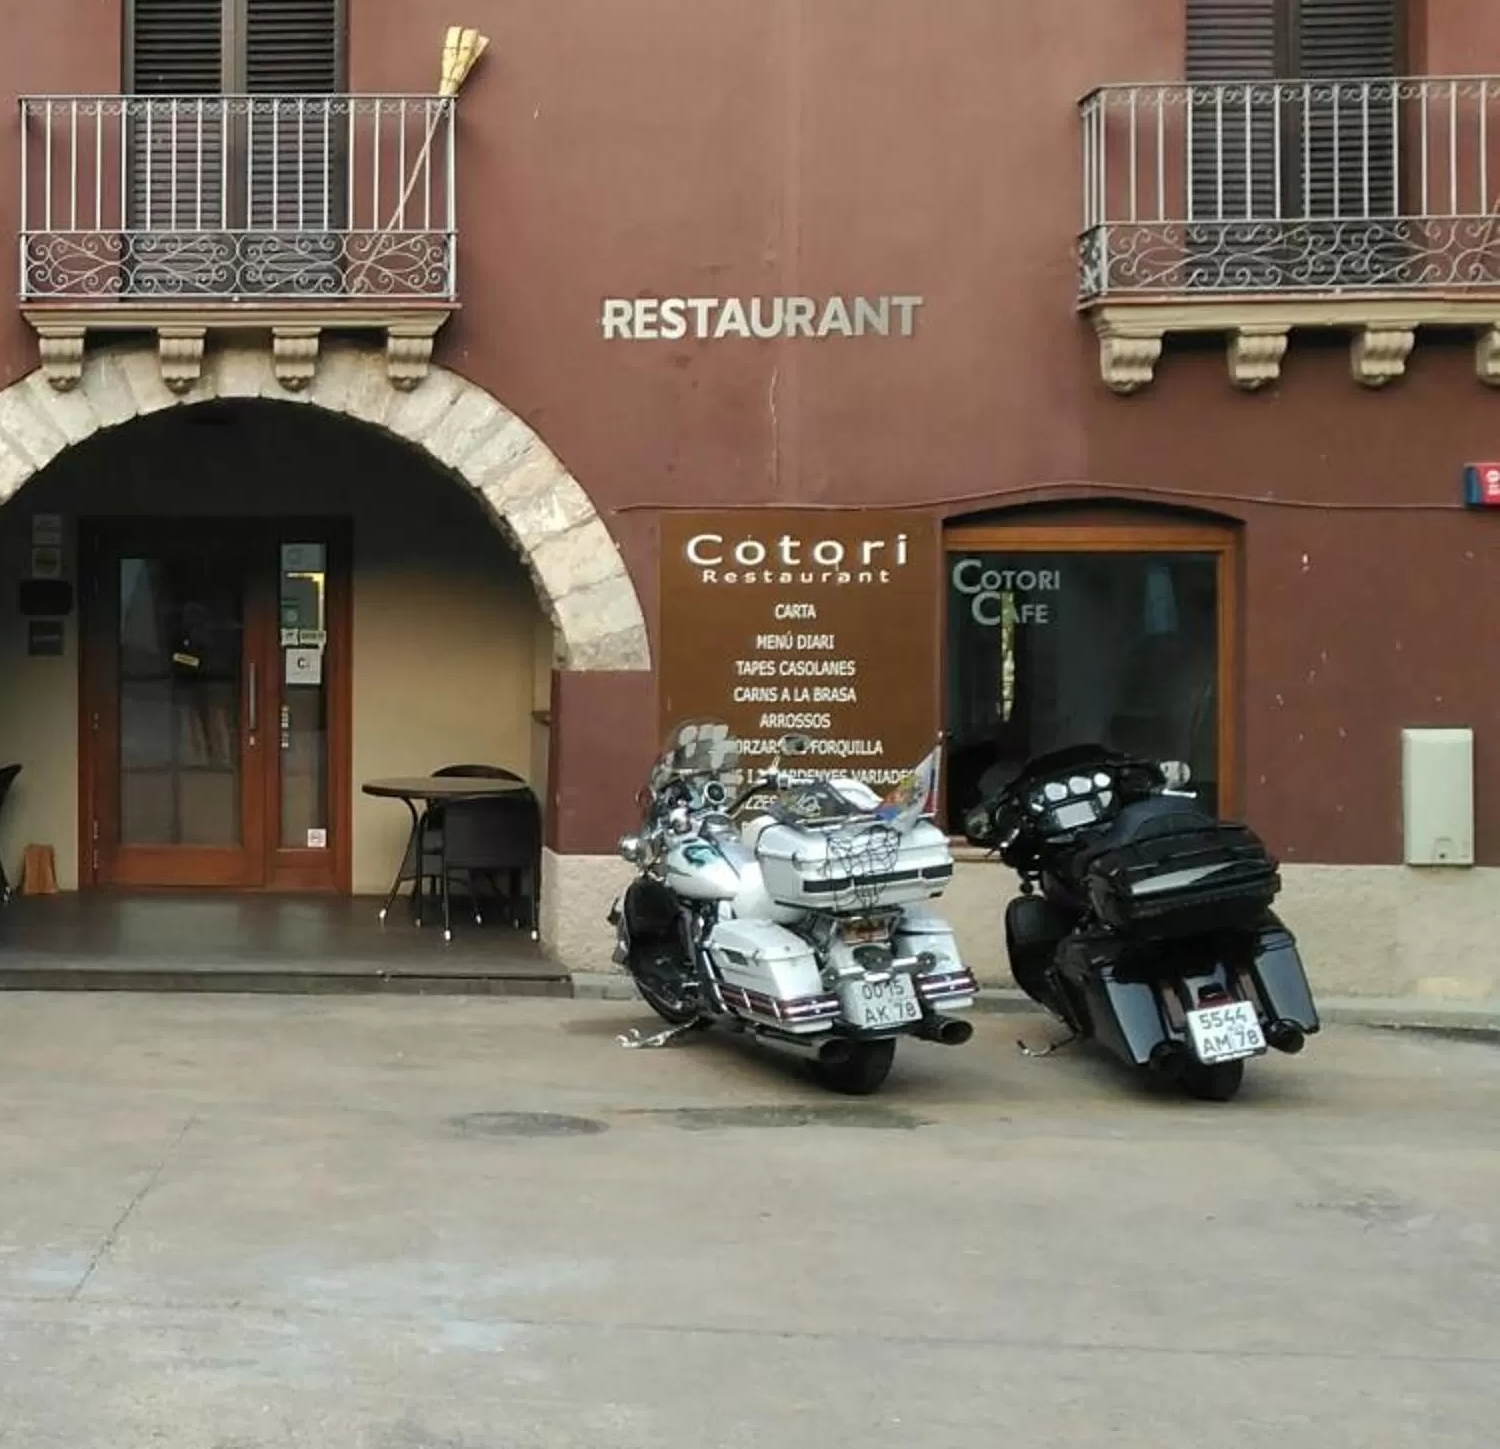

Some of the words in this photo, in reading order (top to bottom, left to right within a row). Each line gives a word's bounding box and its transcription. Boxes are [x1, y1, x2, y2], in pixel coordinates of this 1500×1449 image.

[601, 296, 924, 339] RESTAURANT
[686, 534, 908, 565] Cotori
[702, 569, 891, 584] Restaurant
[774, 603, 817, 619] CARTA
[756, 631, 793, 650] MENÚ
[797, 634, 835, 650] DIARI
[735, 660, 776, 676] TAPES
[779, 660, 856, 676] CASOLANES
[733, 687, 779, 702] CARNS
[781, 687, 791, 702] A
[793, 687, 810, 702] LA
[813, 687, 857, 703] BRASA
[760, 712, 832, 728] ARROSSOS
[810, 739, 884, 758] FORQUILLA
[1199, 1007, 1247, 1029] 5544
[1203, 1034, 1232, 1055] AM
[1234, 1029, 1259, 1048] 78
